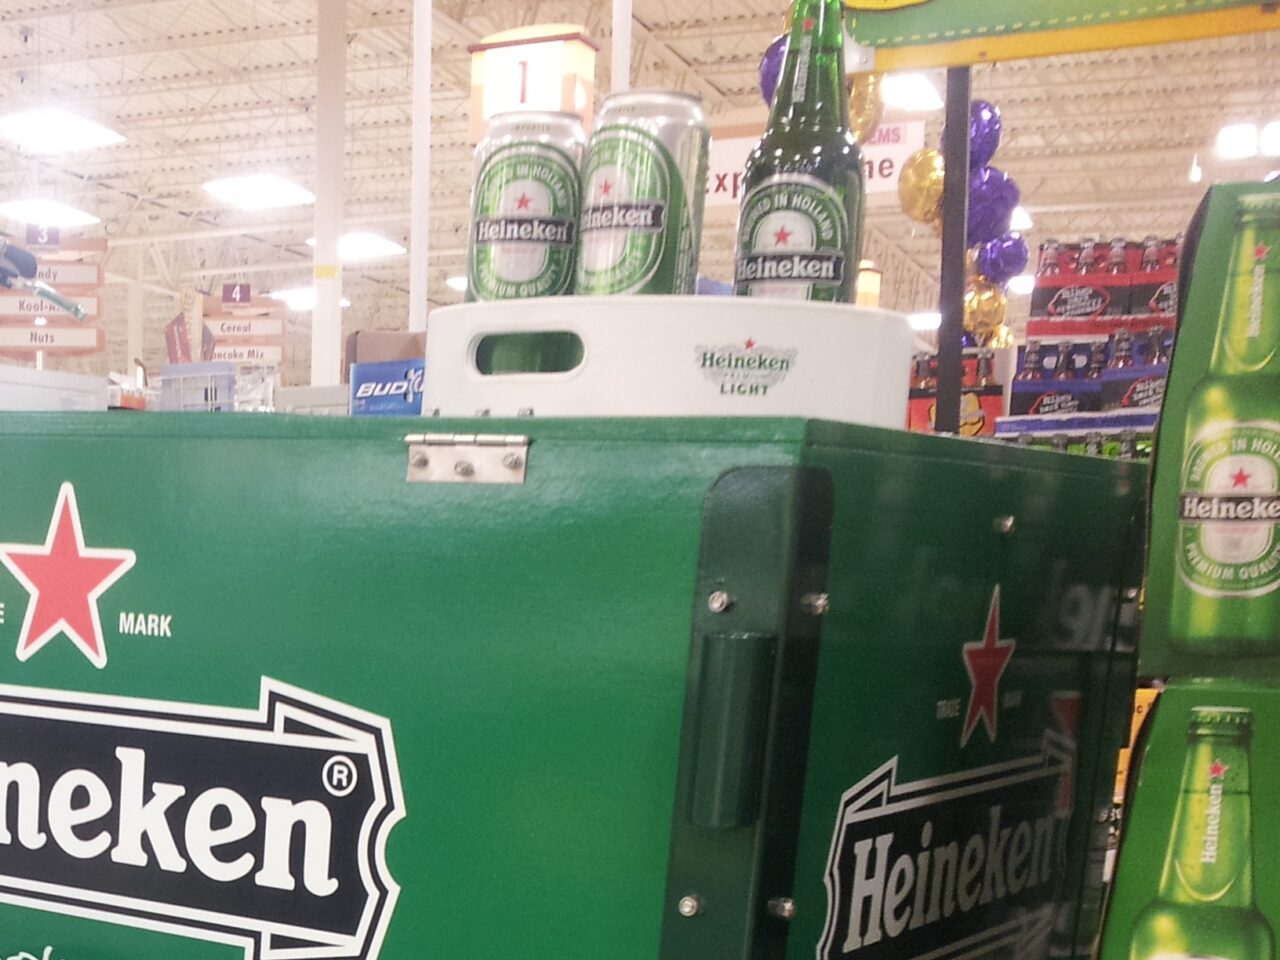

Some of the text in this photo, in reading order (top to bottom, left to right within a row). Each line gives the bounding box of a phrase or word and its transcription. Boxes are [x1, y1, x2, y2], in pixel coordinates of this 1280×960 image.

[517, 61, 528, 103] 1
[774, 192, 789, 207] IN
[791, 194, 834, 241] HOLLAND
[37, 225, 49, 244] 3
[478, 219, 568, 241] Heineken
[736, 255, 836, 281] Heineken
[232, 286, 241, 302] 4
[30, 331, 56, 344] Nuts
[220, 322, 252, 334] Cereal
[247, 350, 265, 360] Mix
[700, 352, 790, 371] Heineken
[720, 383, 770, 396] LIGHT
[1231, 437, 1247, 450] IN
[1186, 542, 1234, 580] PREMIUM
[119, 611, 173, 638] MARK
[1202, 783, 1223, 865] Heineken
[842, 805, 1053, 955] Heineken
